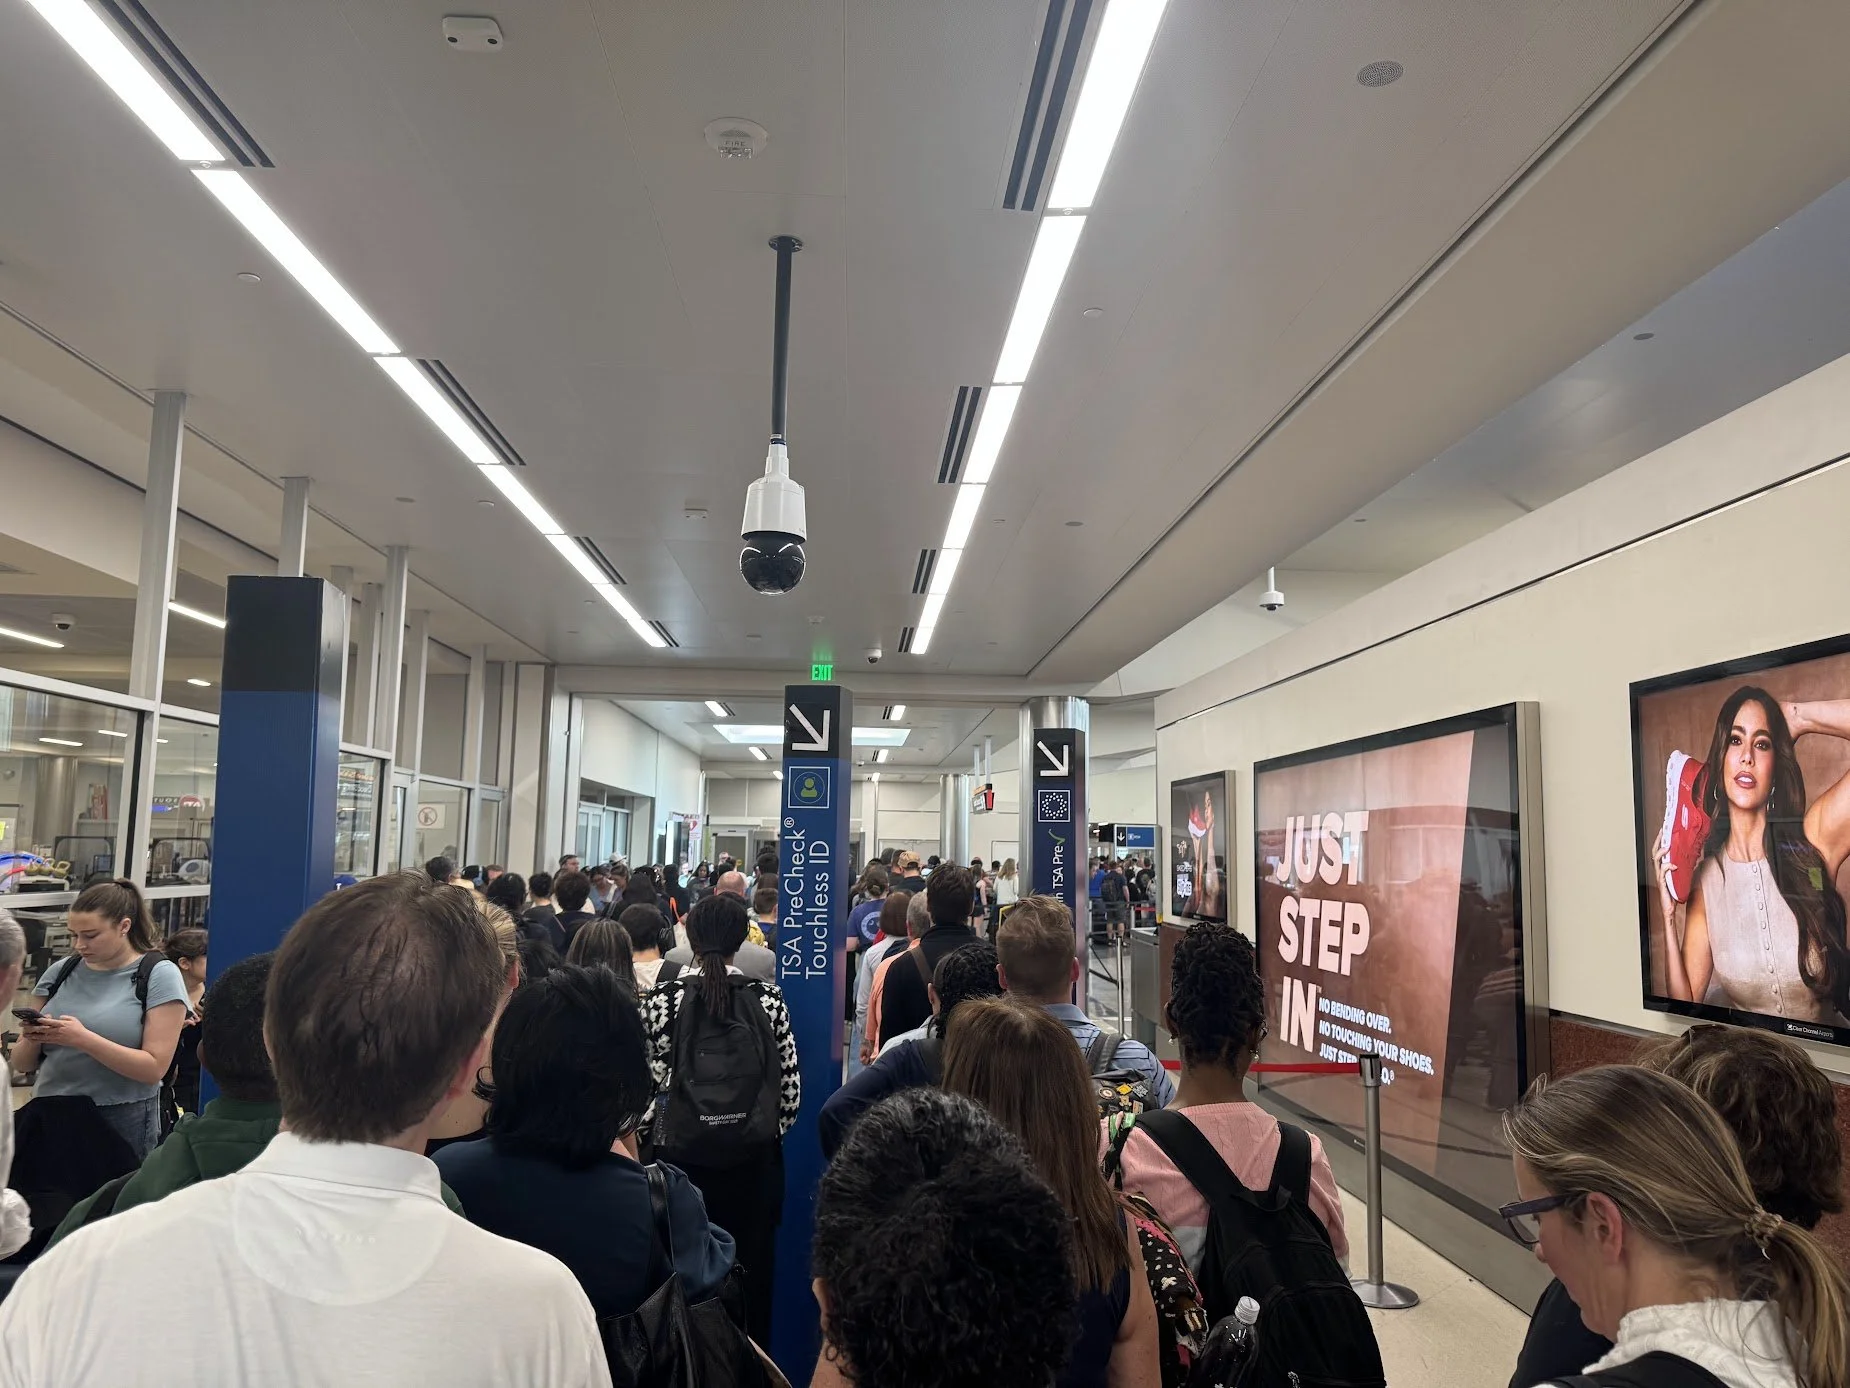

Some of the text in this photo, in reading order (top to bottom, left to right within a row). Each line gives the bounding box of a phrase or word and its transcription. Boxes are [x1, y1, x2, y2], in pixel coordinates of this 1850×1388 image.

[811, 664, 833, 681] EXIT
[1276, 810, 1369, 885] JUST
[1052, 866, 1064, 889] TSA
[805, 840, 830, 980] Touchless ID
[1278, 895, 1370, 976] STEP
[782, 936, 802, 979] TSA
[1319, 997, 1392, 1035] NO BENDING OVER.
[1319, 1019, 1434, 1076] NO TOUCHING YOUR SHOES.
[1319, 1043, 1339, 1063] JUST
[1337, 1049, 1358, 1064] STEP
